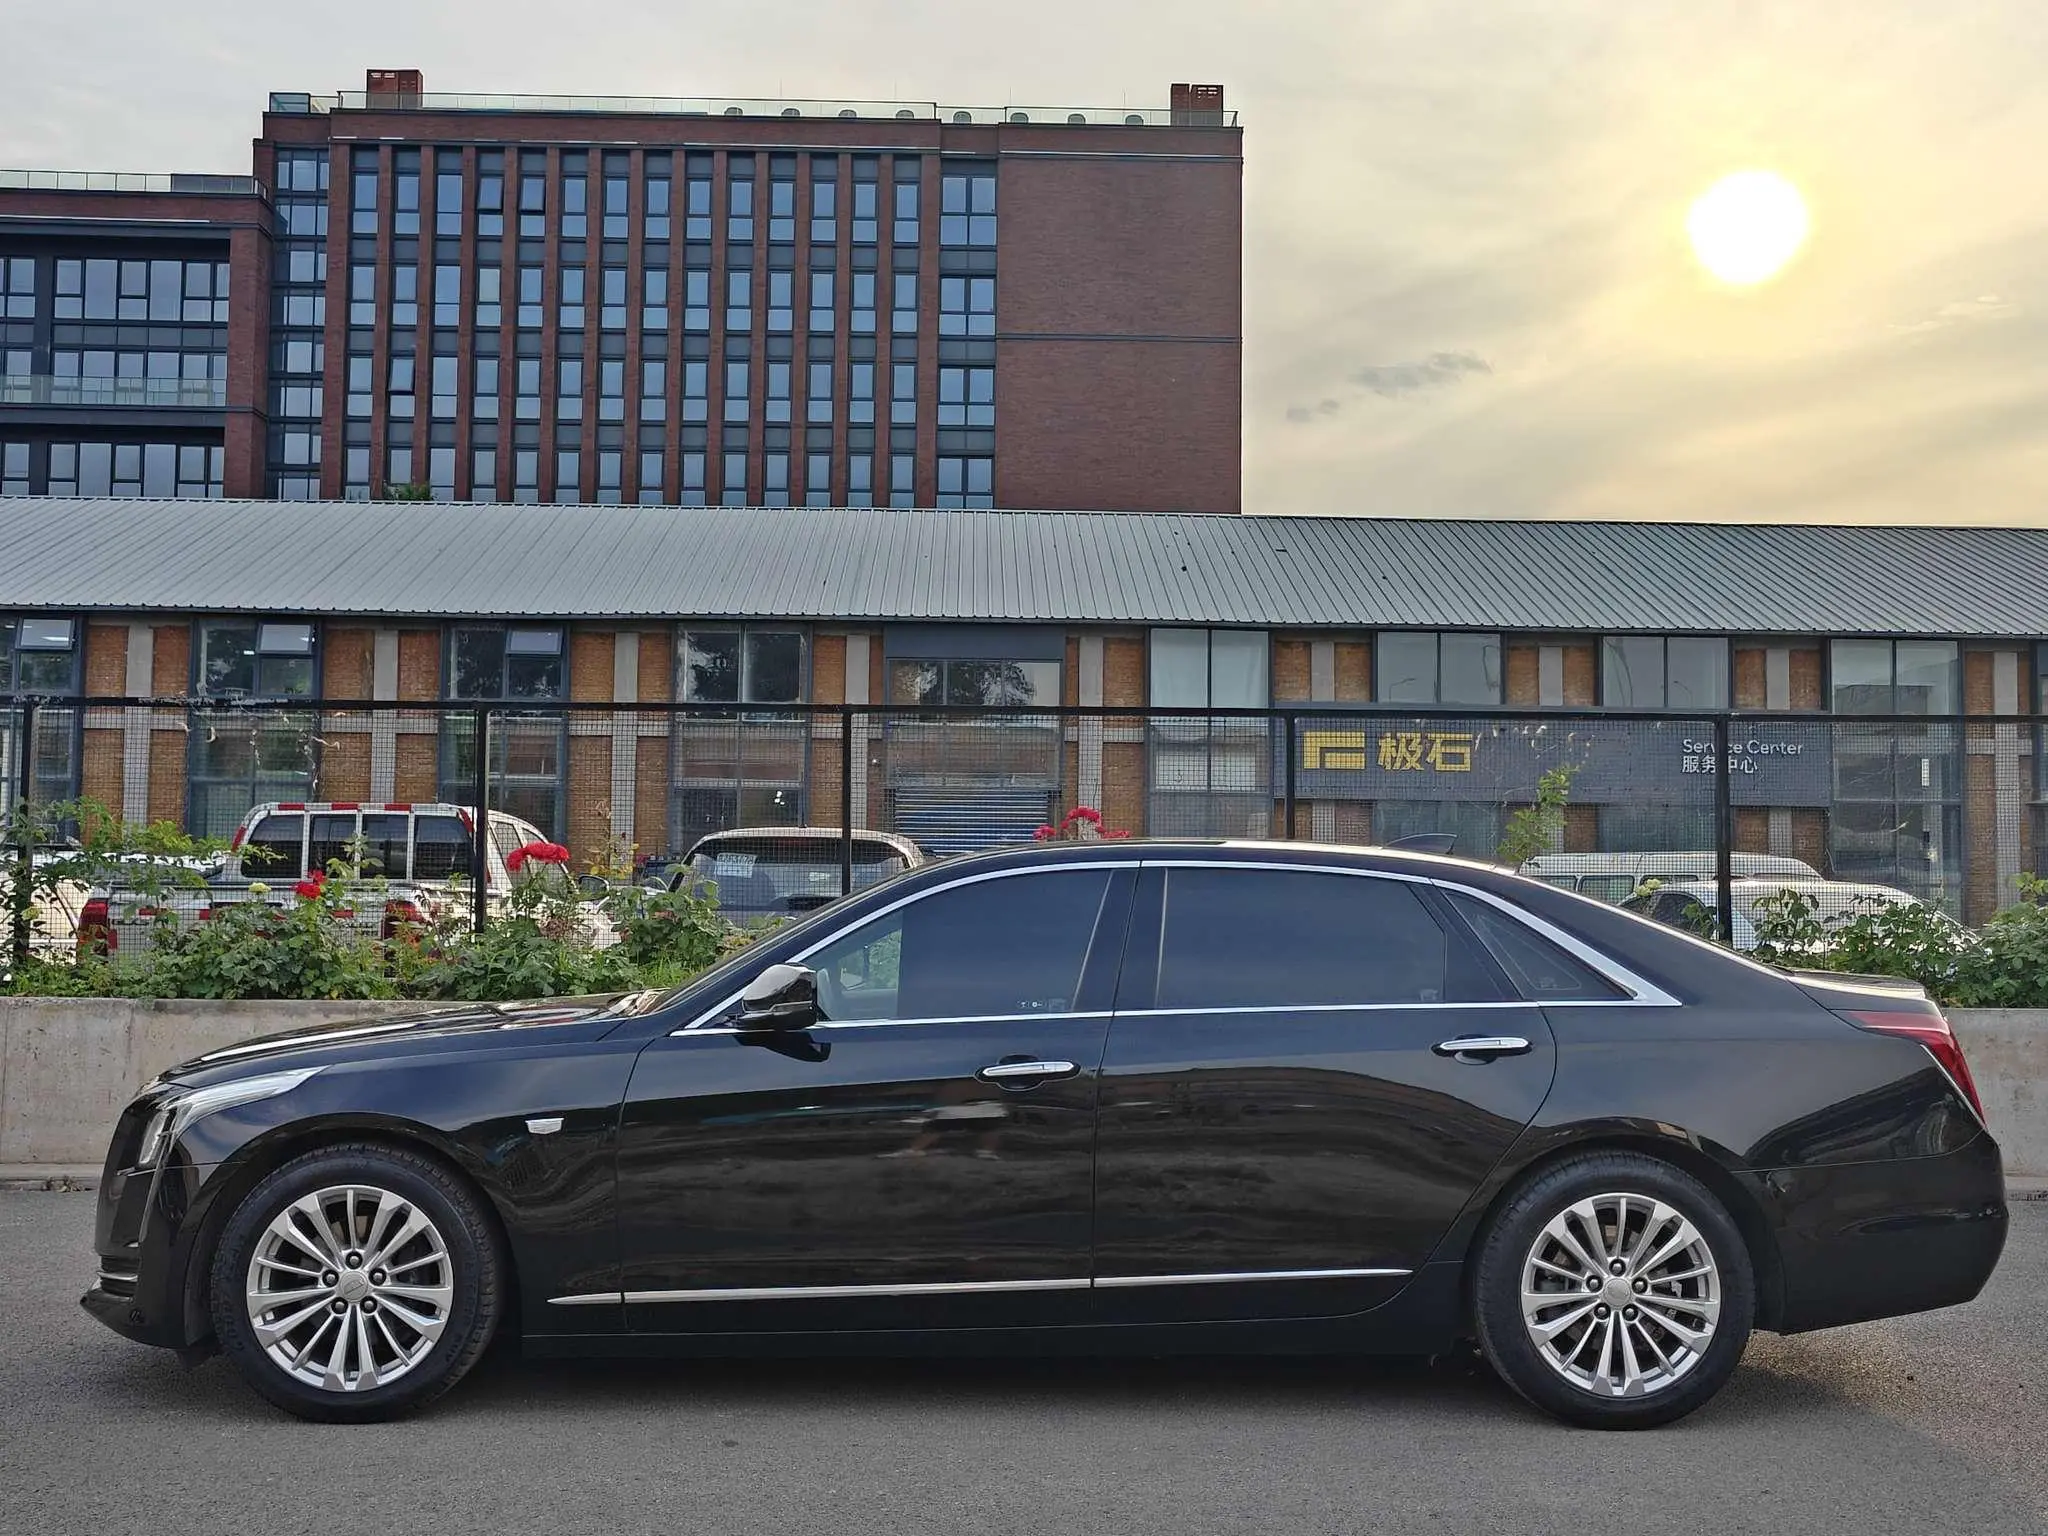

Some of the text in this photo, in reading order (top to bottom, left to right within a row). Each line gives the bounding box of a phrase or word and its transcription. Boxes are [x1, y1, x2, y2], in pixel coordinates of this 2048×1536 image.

[1378, 732, 1473, 771] 极石
[1682, 739, 1803, 755] Servce Center
